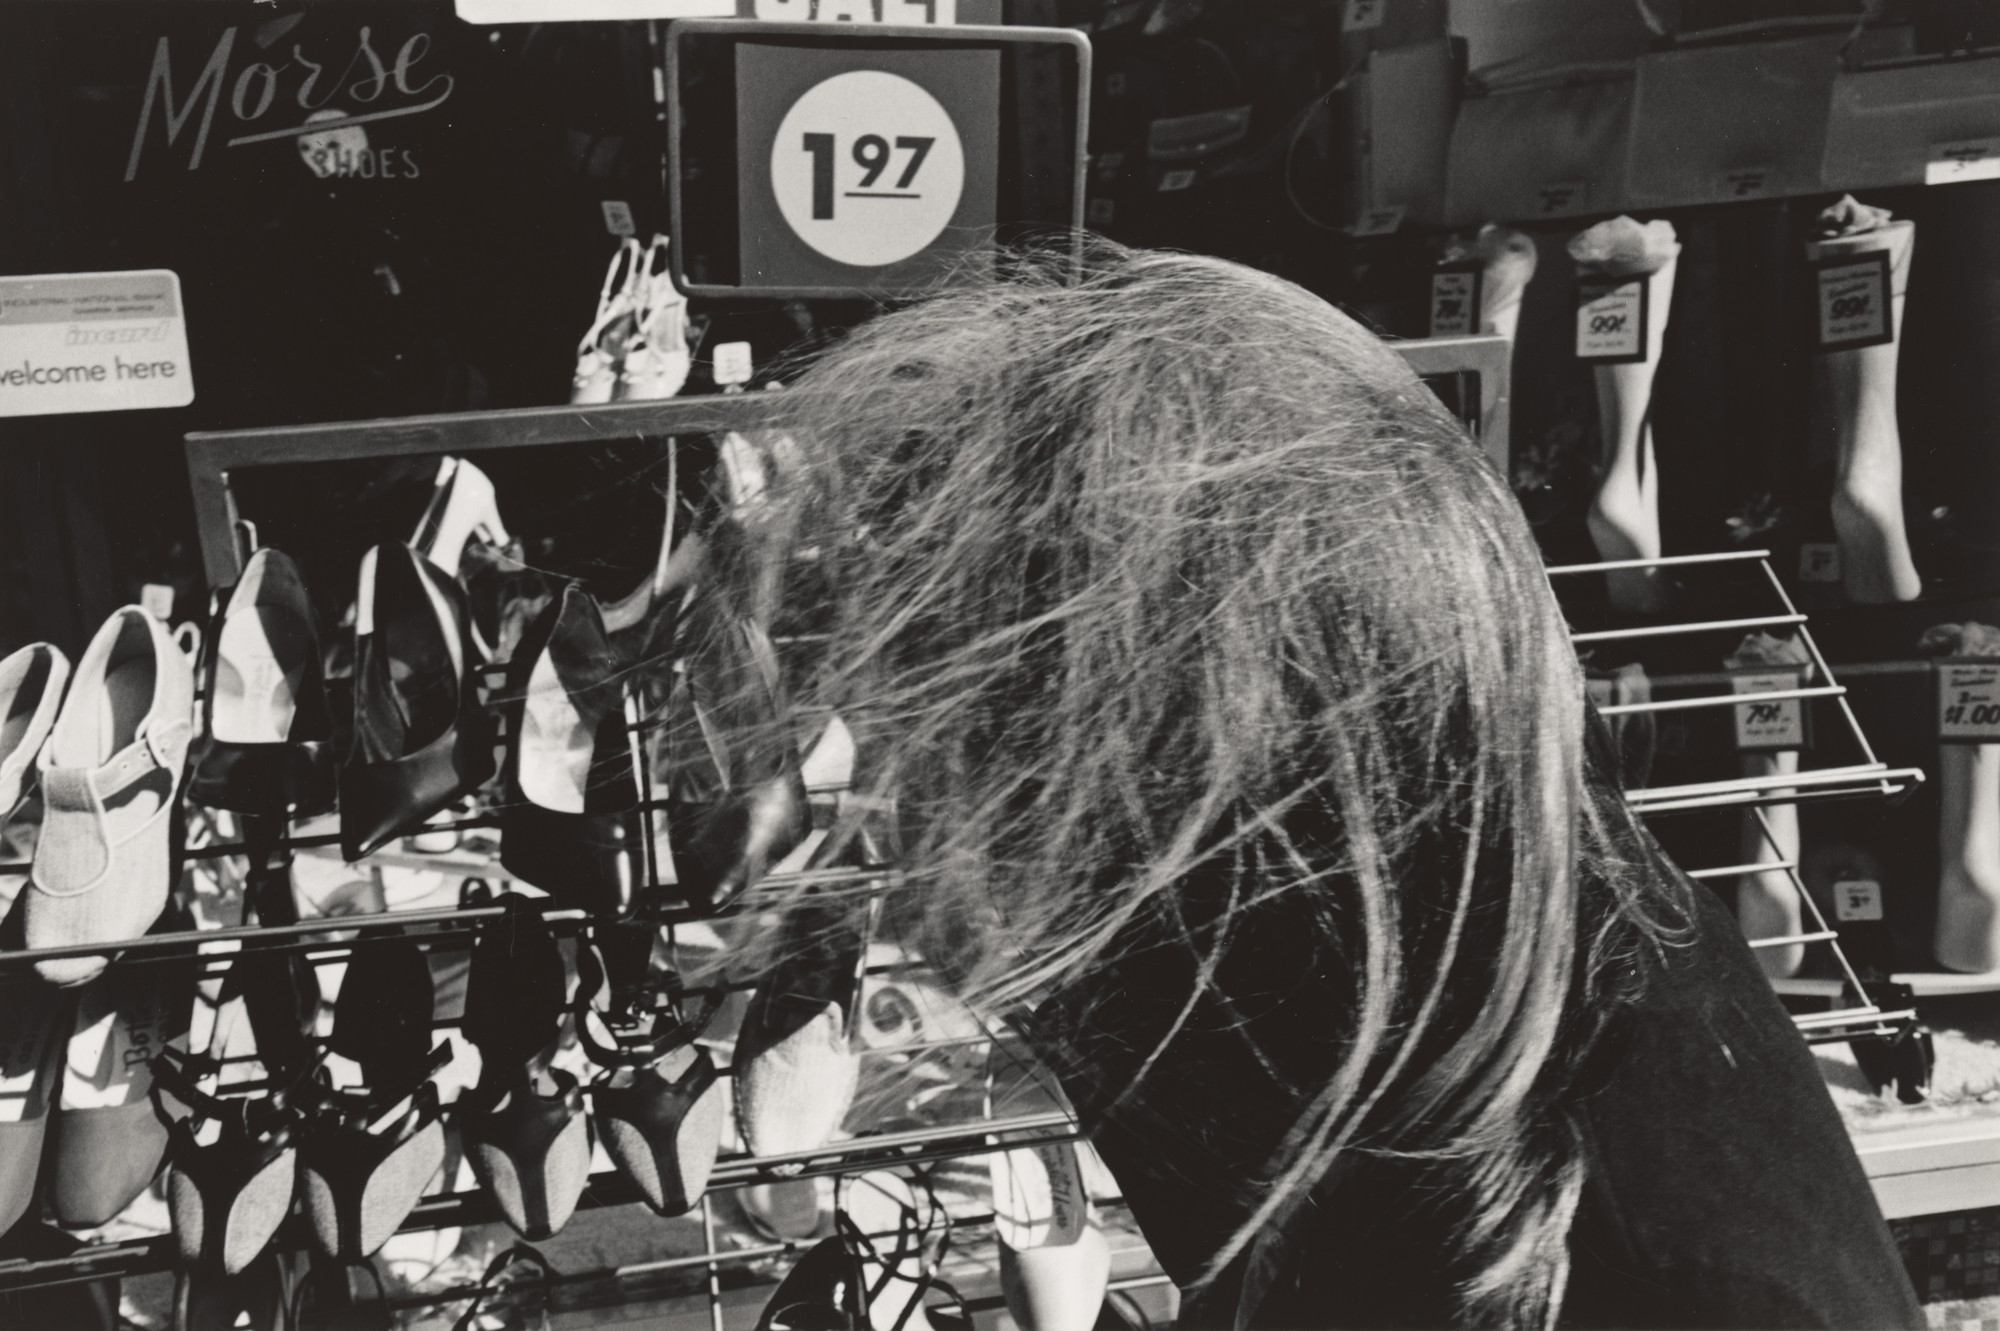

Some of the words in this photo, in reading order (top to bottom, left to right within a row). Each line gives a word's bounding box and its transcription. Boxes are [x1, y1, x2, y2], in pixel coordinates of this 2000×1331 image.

[124, 26, 454, 182] Morse
[309, 148, 421, 180] SHOES
[114, 354, 176, 380] here
